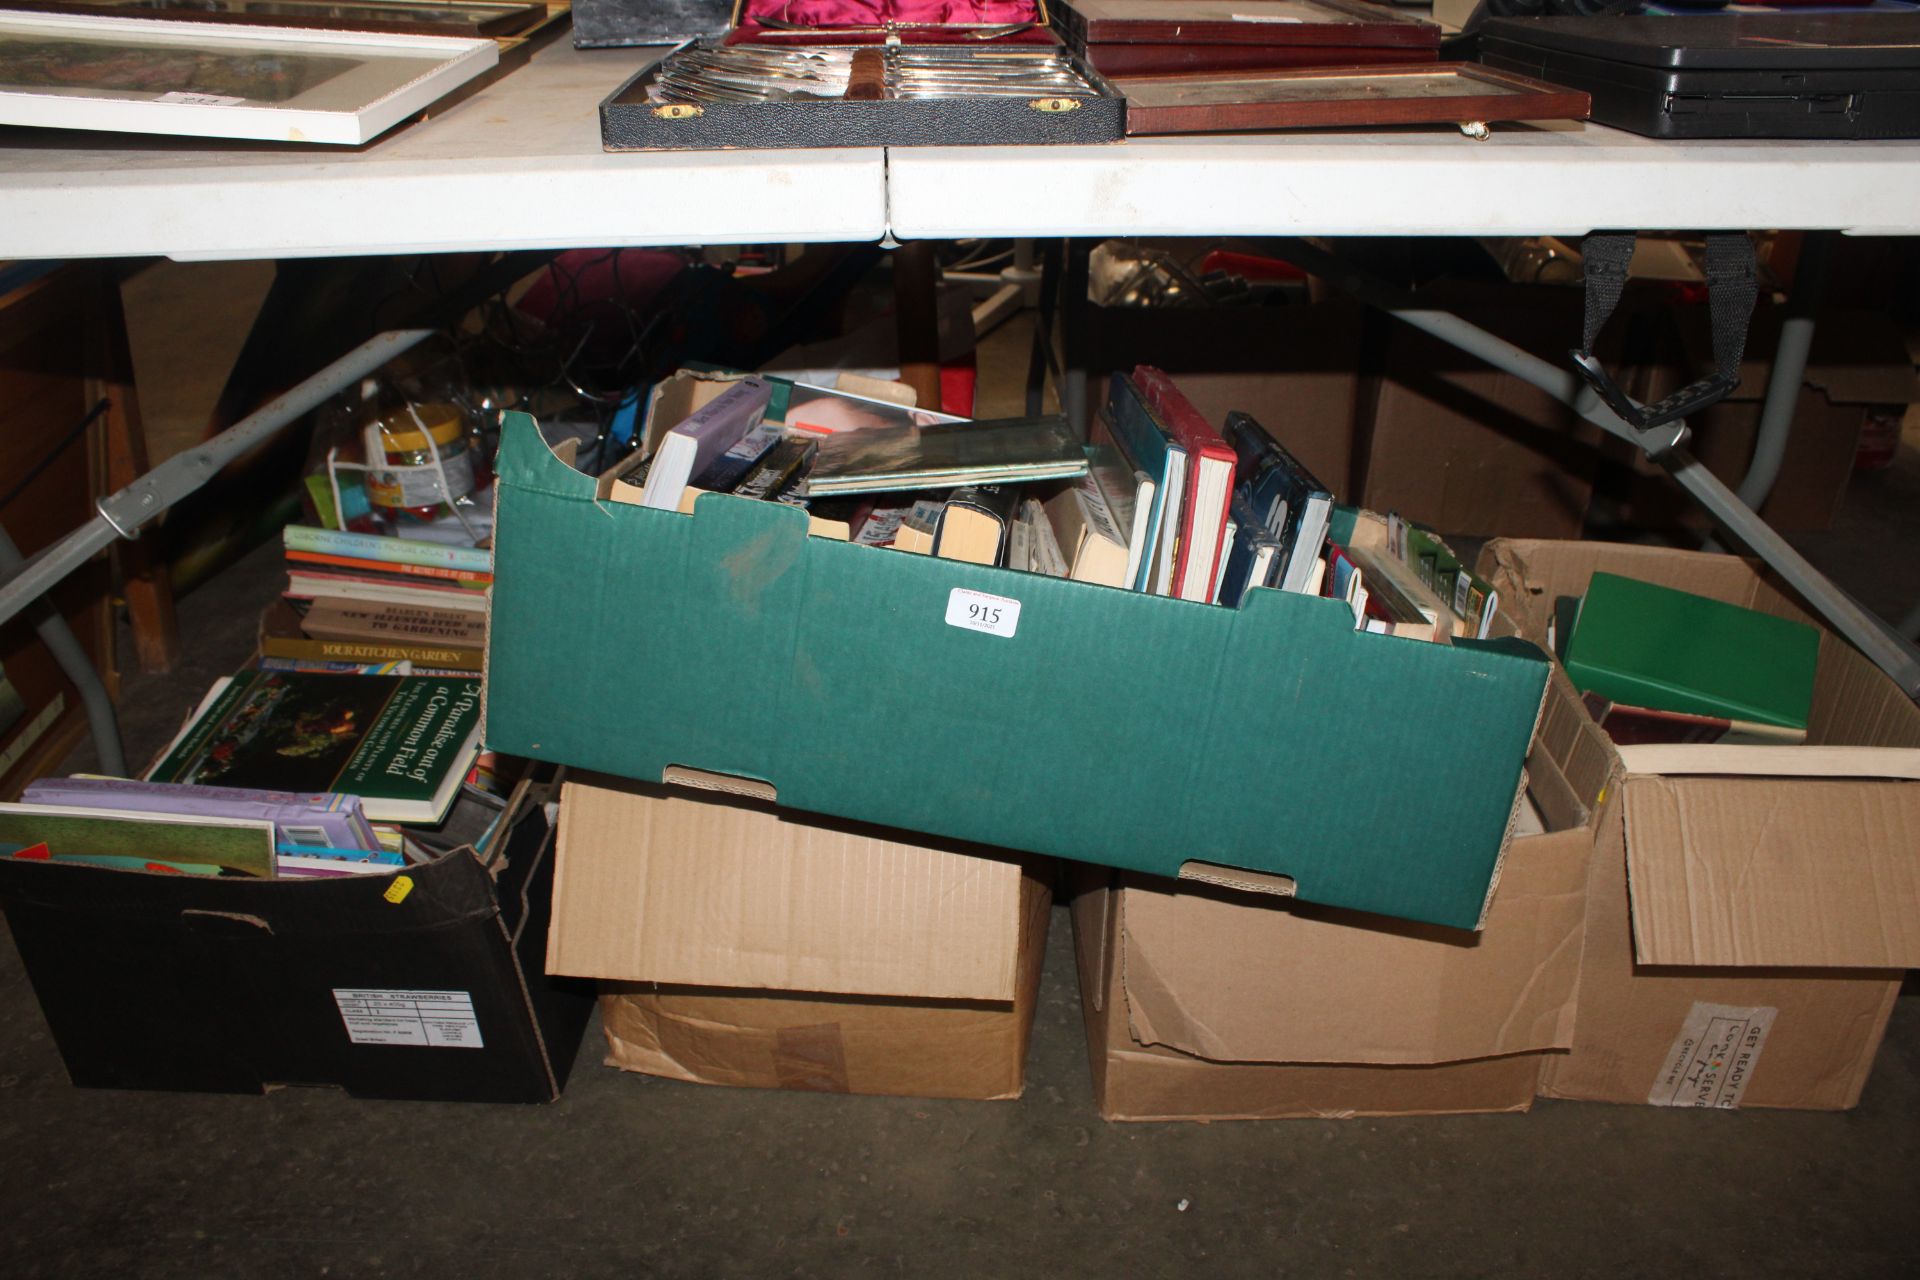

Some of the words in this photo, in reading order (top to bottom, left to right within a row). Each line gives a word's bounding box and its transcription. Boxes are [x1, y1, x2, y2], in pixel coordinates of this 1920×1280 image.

[969, 603, 1002, 624] 915
[372, 622, 387, 631] TO
[392, 624, 469, 637] GARDENING
[322, 644, 354, 657] YOUR
[353, 646, 408, 659] KITCHEN
[410, 649, 462, 662] GARDEN
[436, 686, 449, 695] a
[404, 695, 448, 746] Common
[431, 697, 473, 749] Paradise
[385, 746, 418, 776] Field
[418, 748, 439, 768] out
[406, 769, 428, 784] of
[390, 993, 453, 1001] STRAWBERRIES
[1744, 1026, 1761, 1049] GET
[1728, 1052, 1752, 1089] READY
[1694, 1072, 1717, 1108] SERVE
